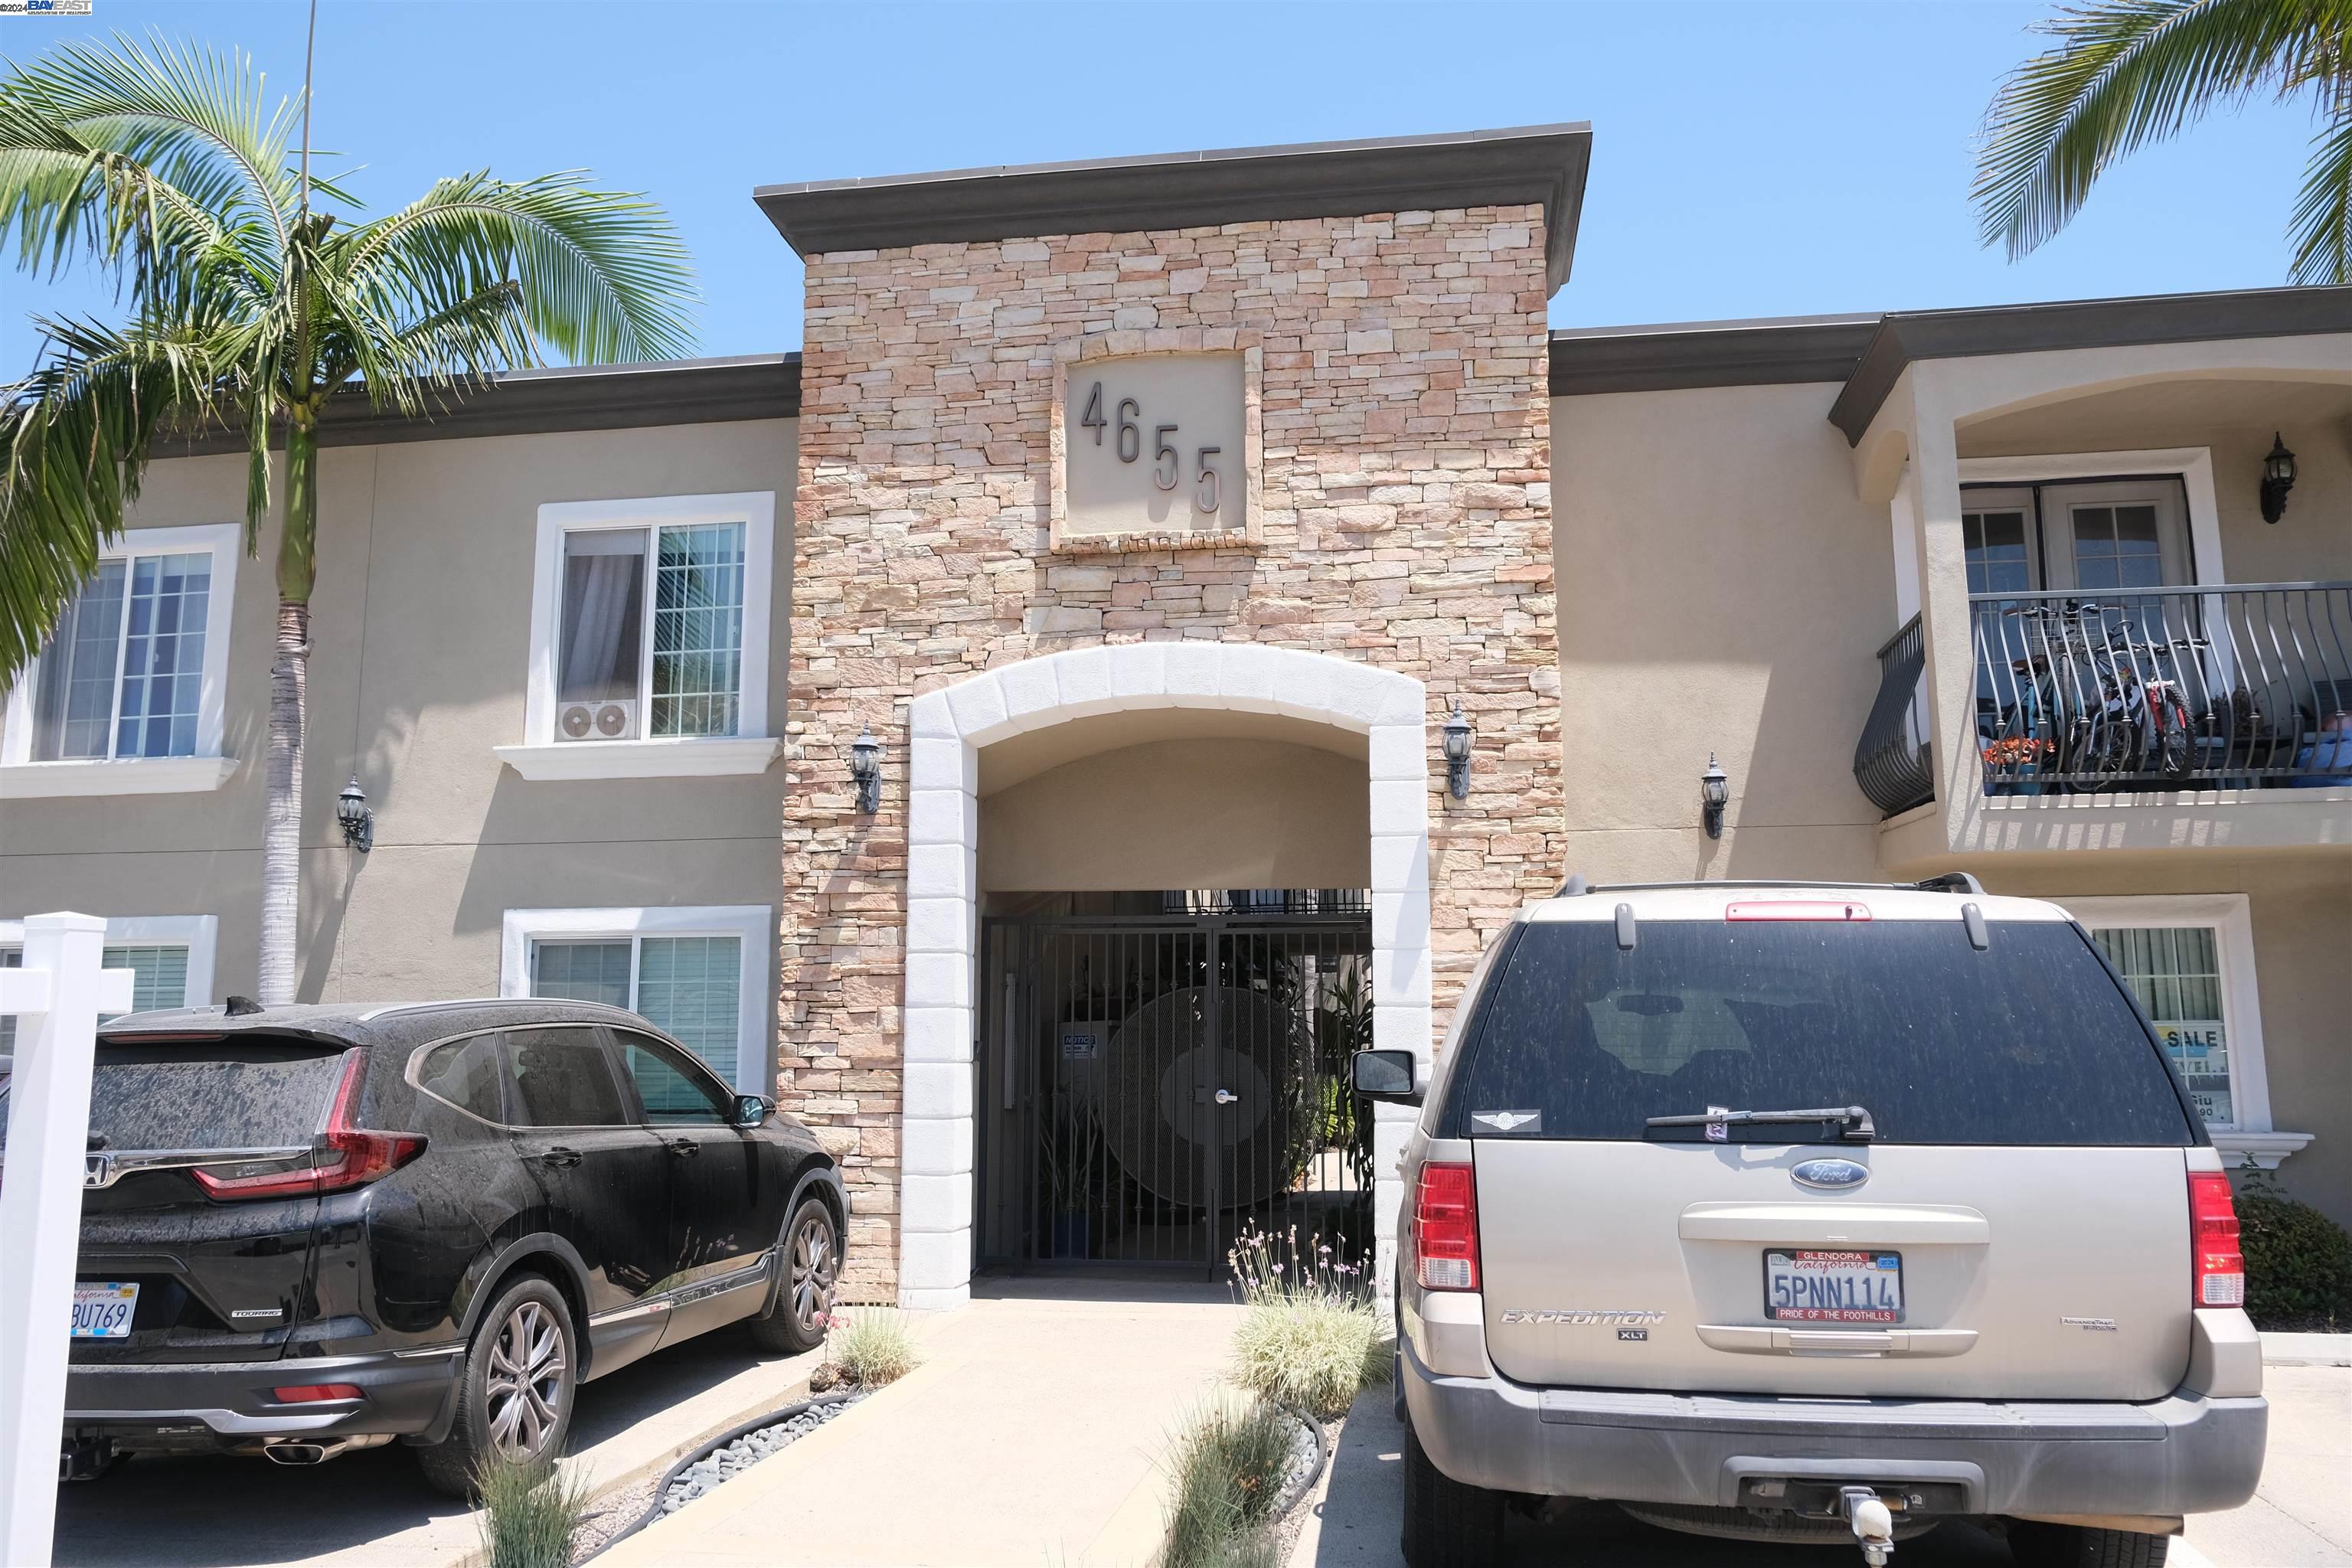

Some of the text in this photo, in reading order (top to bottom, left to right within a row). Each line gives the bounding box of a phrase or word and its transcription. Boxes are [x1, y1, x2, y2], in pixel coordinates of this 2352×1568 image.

[1081, 381, 1221, 514] 4655
[2167, 1031, 2218, 1047] SALE
[1809, 1162, 1852, 1181] Ford
[1804, 1252, 1862, 1260] GLENDORA
[1794, 1260, 1877, 1274] California
[1774, 1273, 1895, 1311] 5PNN114
[1500, 1309, 1667, 1325] EXPEDITION
[1780, 1310, 1890, 1321] PRIDE OF THE FOOTHILLS
